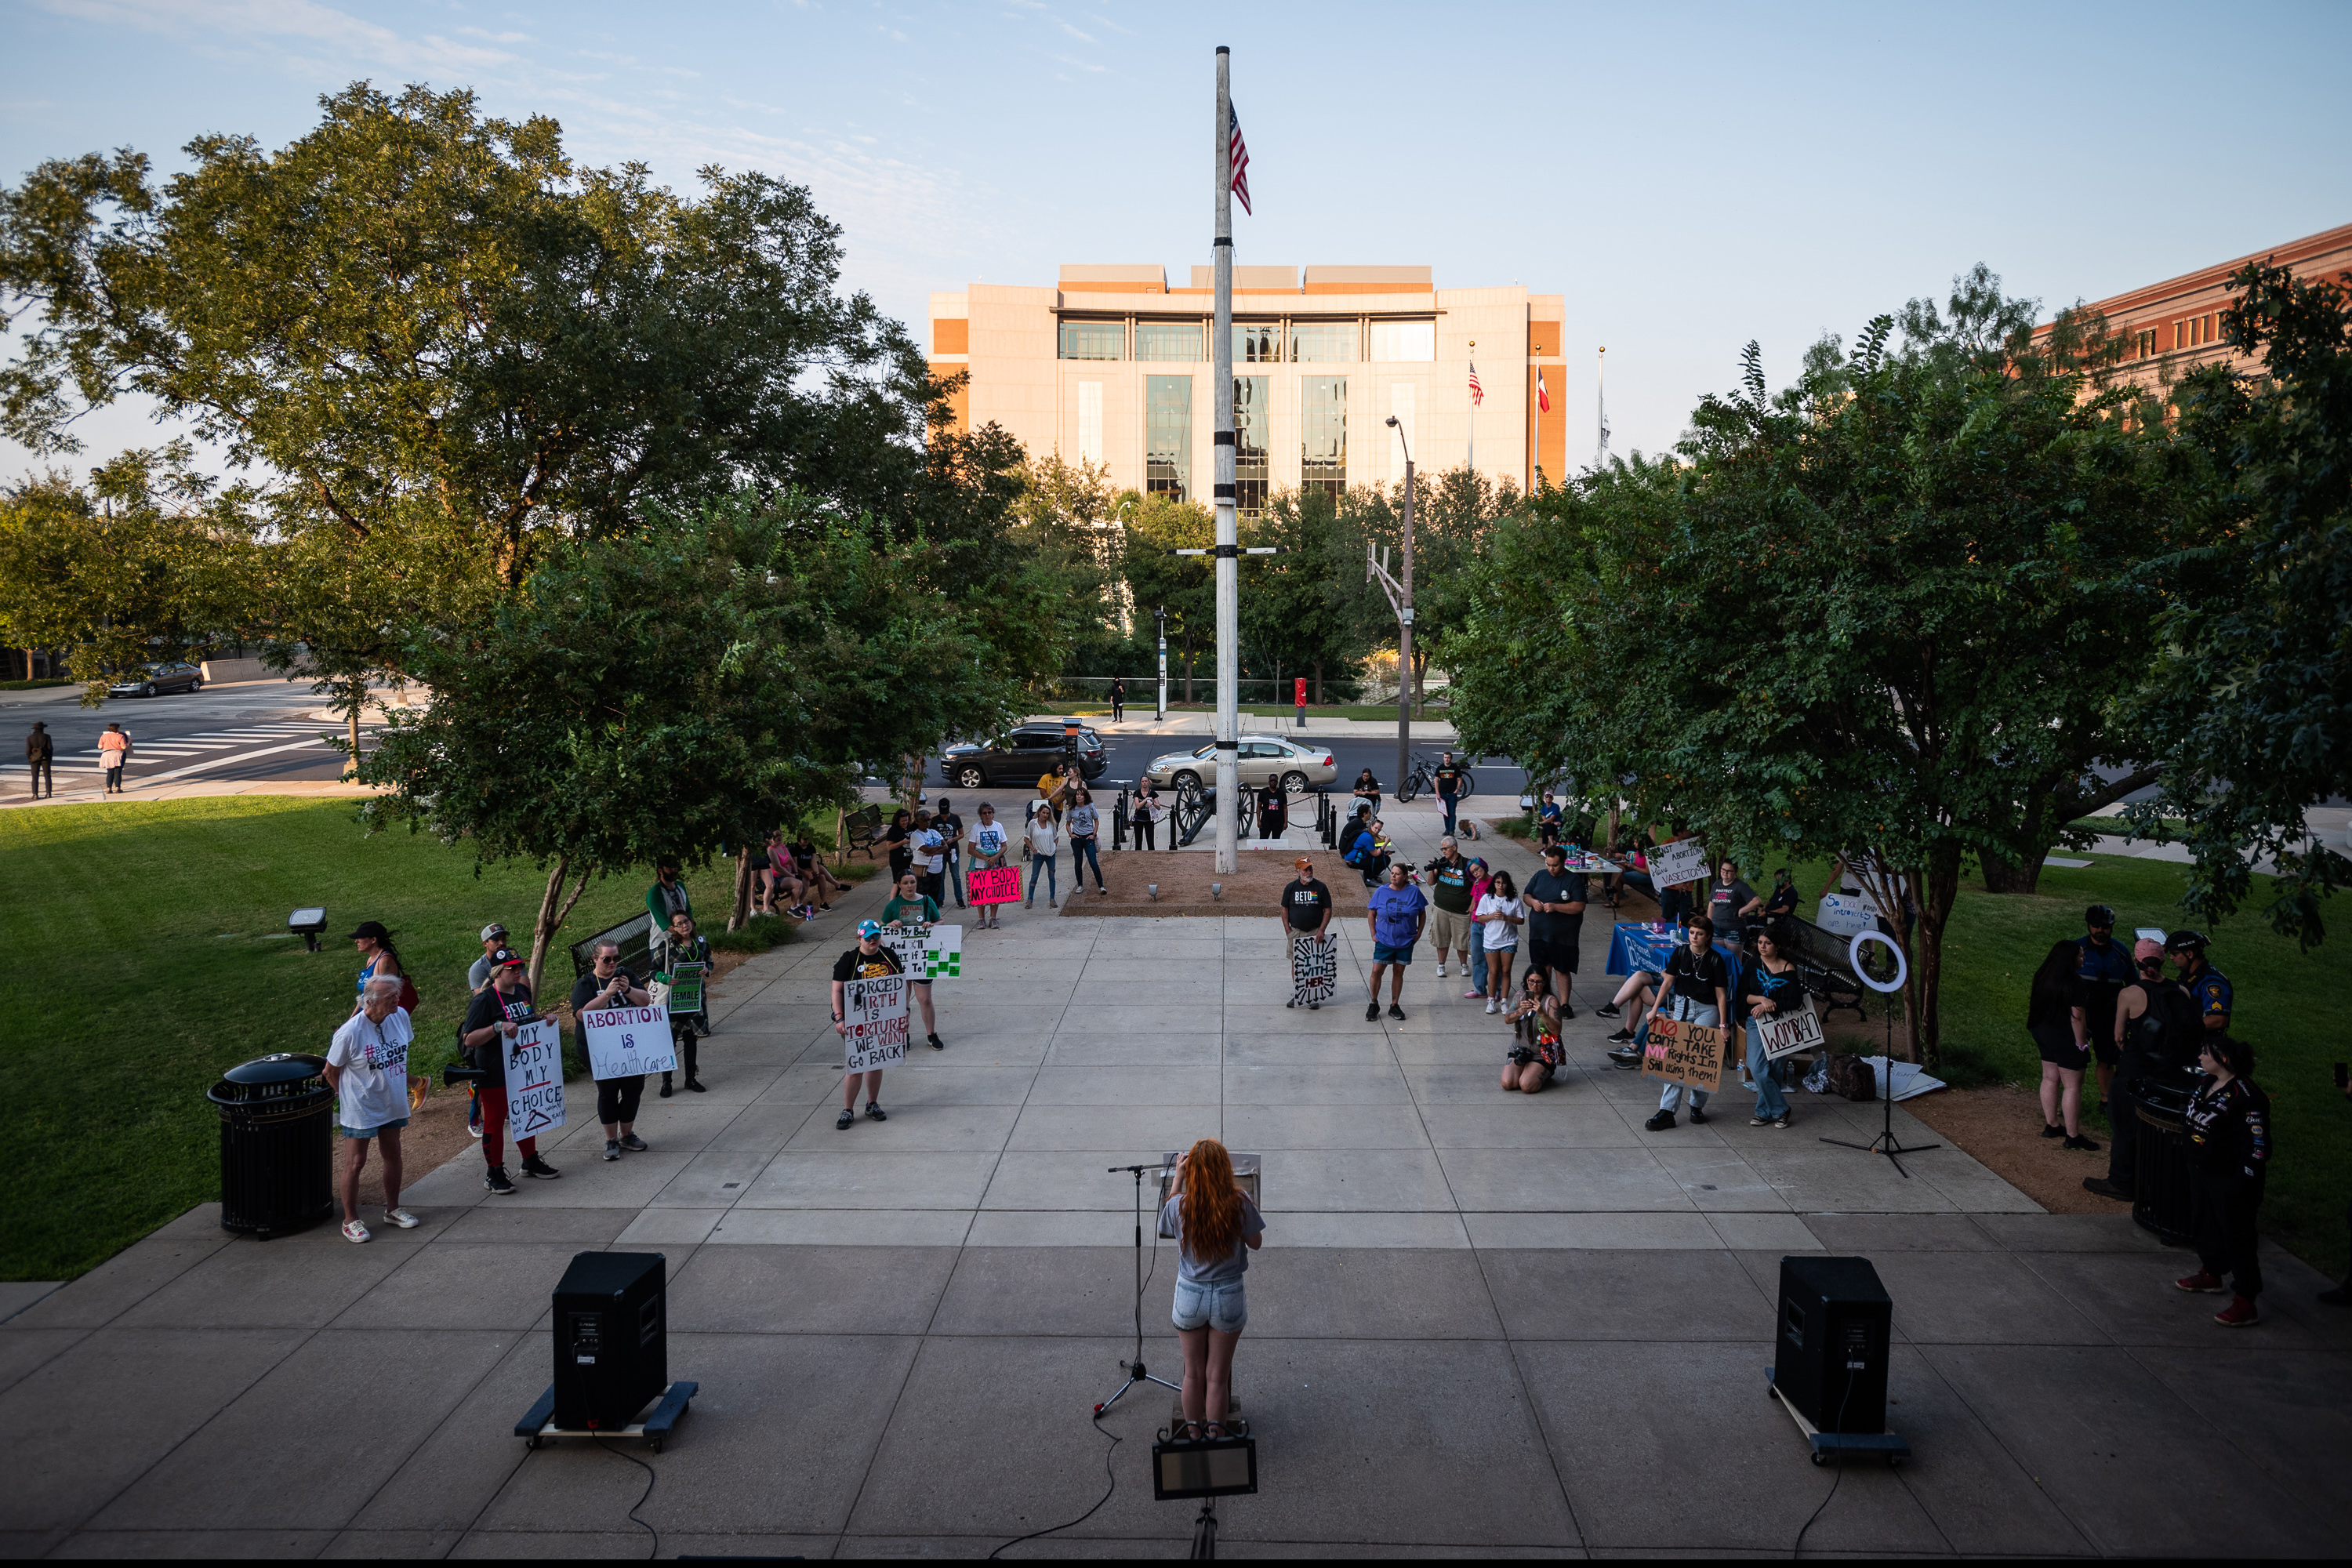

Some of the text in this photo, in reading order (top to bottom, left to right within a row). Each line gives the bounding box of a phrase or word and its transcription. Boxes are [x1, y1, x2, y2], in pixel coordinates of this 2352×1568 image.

[1672, 847, 1701, 861] ABORTION
[971, 868, 1019, 887] MY BODY
[1662, 863, 1709, 884] VASECTOMY!
[971, 882, 1019, 901] MY CHOICE!
[1295, 891, 1312, 901] BETO
[1826, 895, 1839, 907] So
[1834, 909, 1871, 920] introverts
[883, 927, 931, 938] It's My Body
[890, 940, 906, 949] And
[912, 951, 918, 960] if
[1304, 953, 1325, 967] I'M
[912, 961, 926, 972] To!
[1301, 964, 1328, 977] WITH
[848, 978, 903, 997] FORCED
[1305, 976, 1323, 988] HER
[672, 991, 699, 1001] FEMALE
[503, 1001, 529, 1019] BETO
[587, 1007, 662, 1029] ABORTION
[864, 1009, 880, 1022] IS
[520, 1025, 539, 1045] MY
[621, 1033, 634, 1049] IS
[1688, 1025, 1715, 1044] YOU
[365, 1040, 398, 1059] #BANS
[855, 1036, 874, 1054] WE
[1683, 1039, 1716, 1058] TAKE
[368, 1045, 407, 1064] OFF OUR
[368, 1054, 405, 1070] BODIES
[510, 1043, 553, 1070] BODY
[848, 1044, 906, 1069] GO BACK!
[1646, 1044, 1668, 1059] MY
[1668, 1049, 1697, 1065] Rights
[526, 1065, 547, 1087] MY
[1665, 1063, 1685, 1080] using
[1688, 1066, 1717, 1083] them!
[511, 1086, 562, 1115] CHOICE
[511, 1117, 522, 1126] WE
